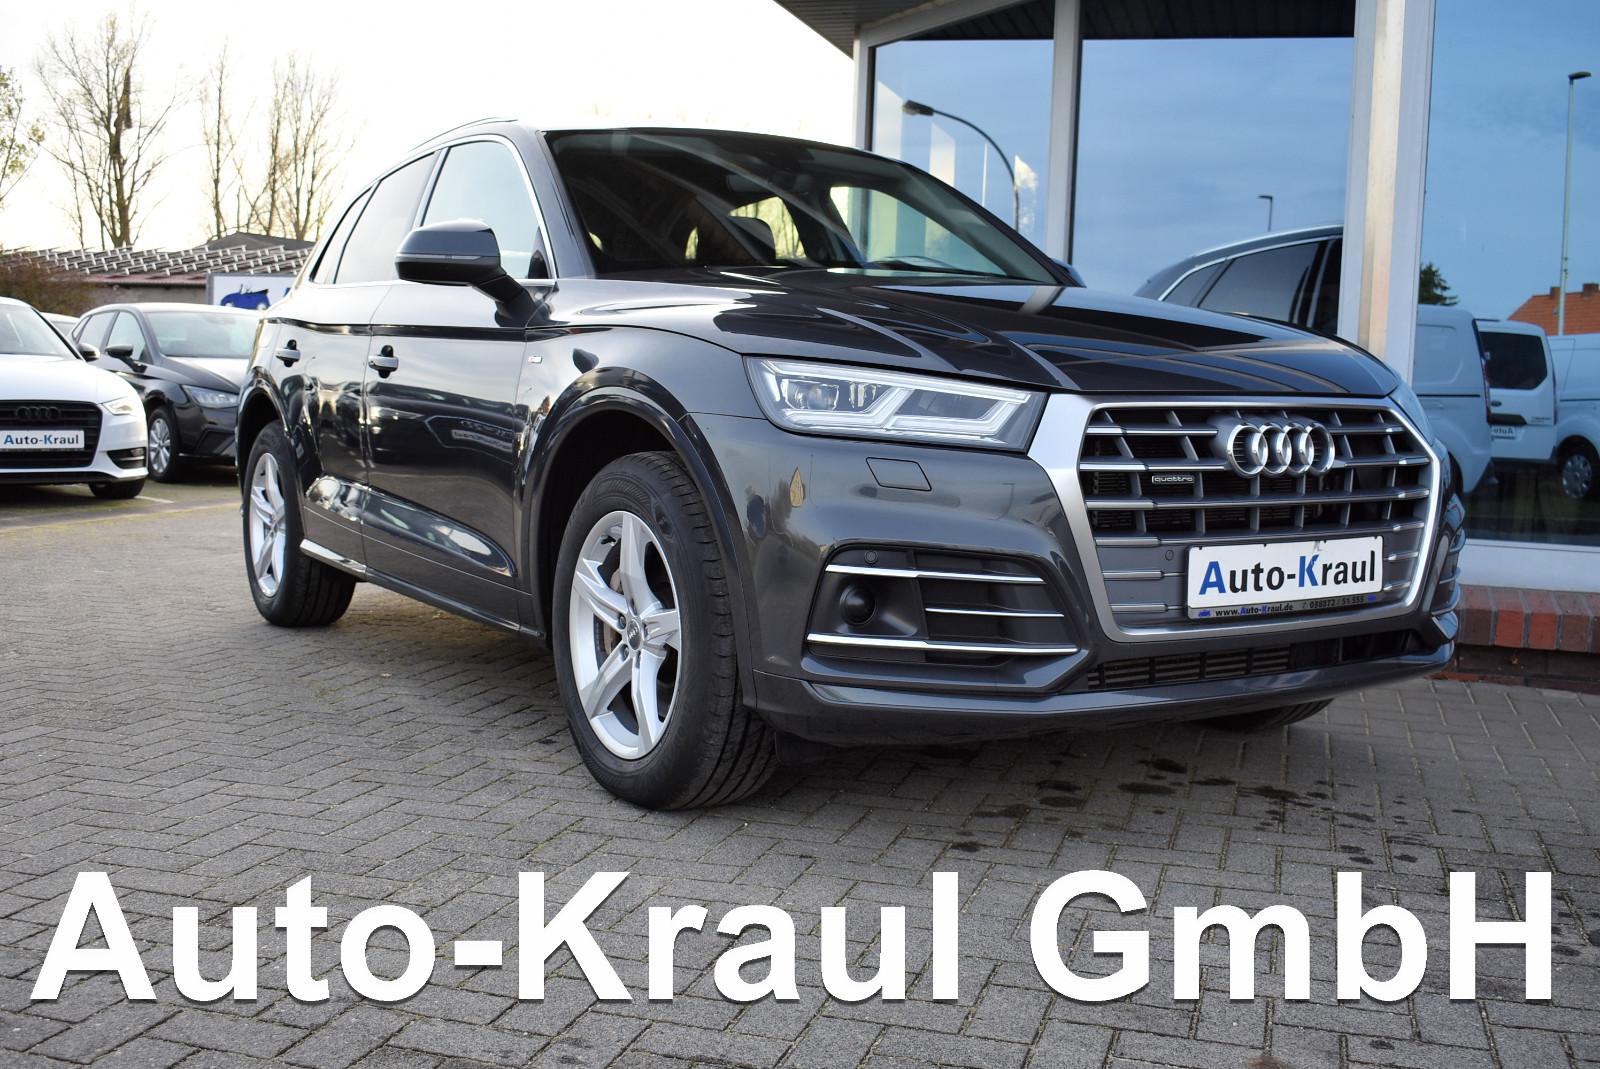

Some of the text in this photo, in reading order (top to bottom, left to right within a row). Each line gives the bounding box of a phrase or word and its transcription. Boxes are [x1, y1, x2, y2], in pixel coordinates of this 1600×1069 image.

[3, 434, 79, 445] Auto-Kraul
[1198, 550, 1376, 595] Auto-Kraul
[1215, 603, 1293, 616] www.Auto-Kraul.de
